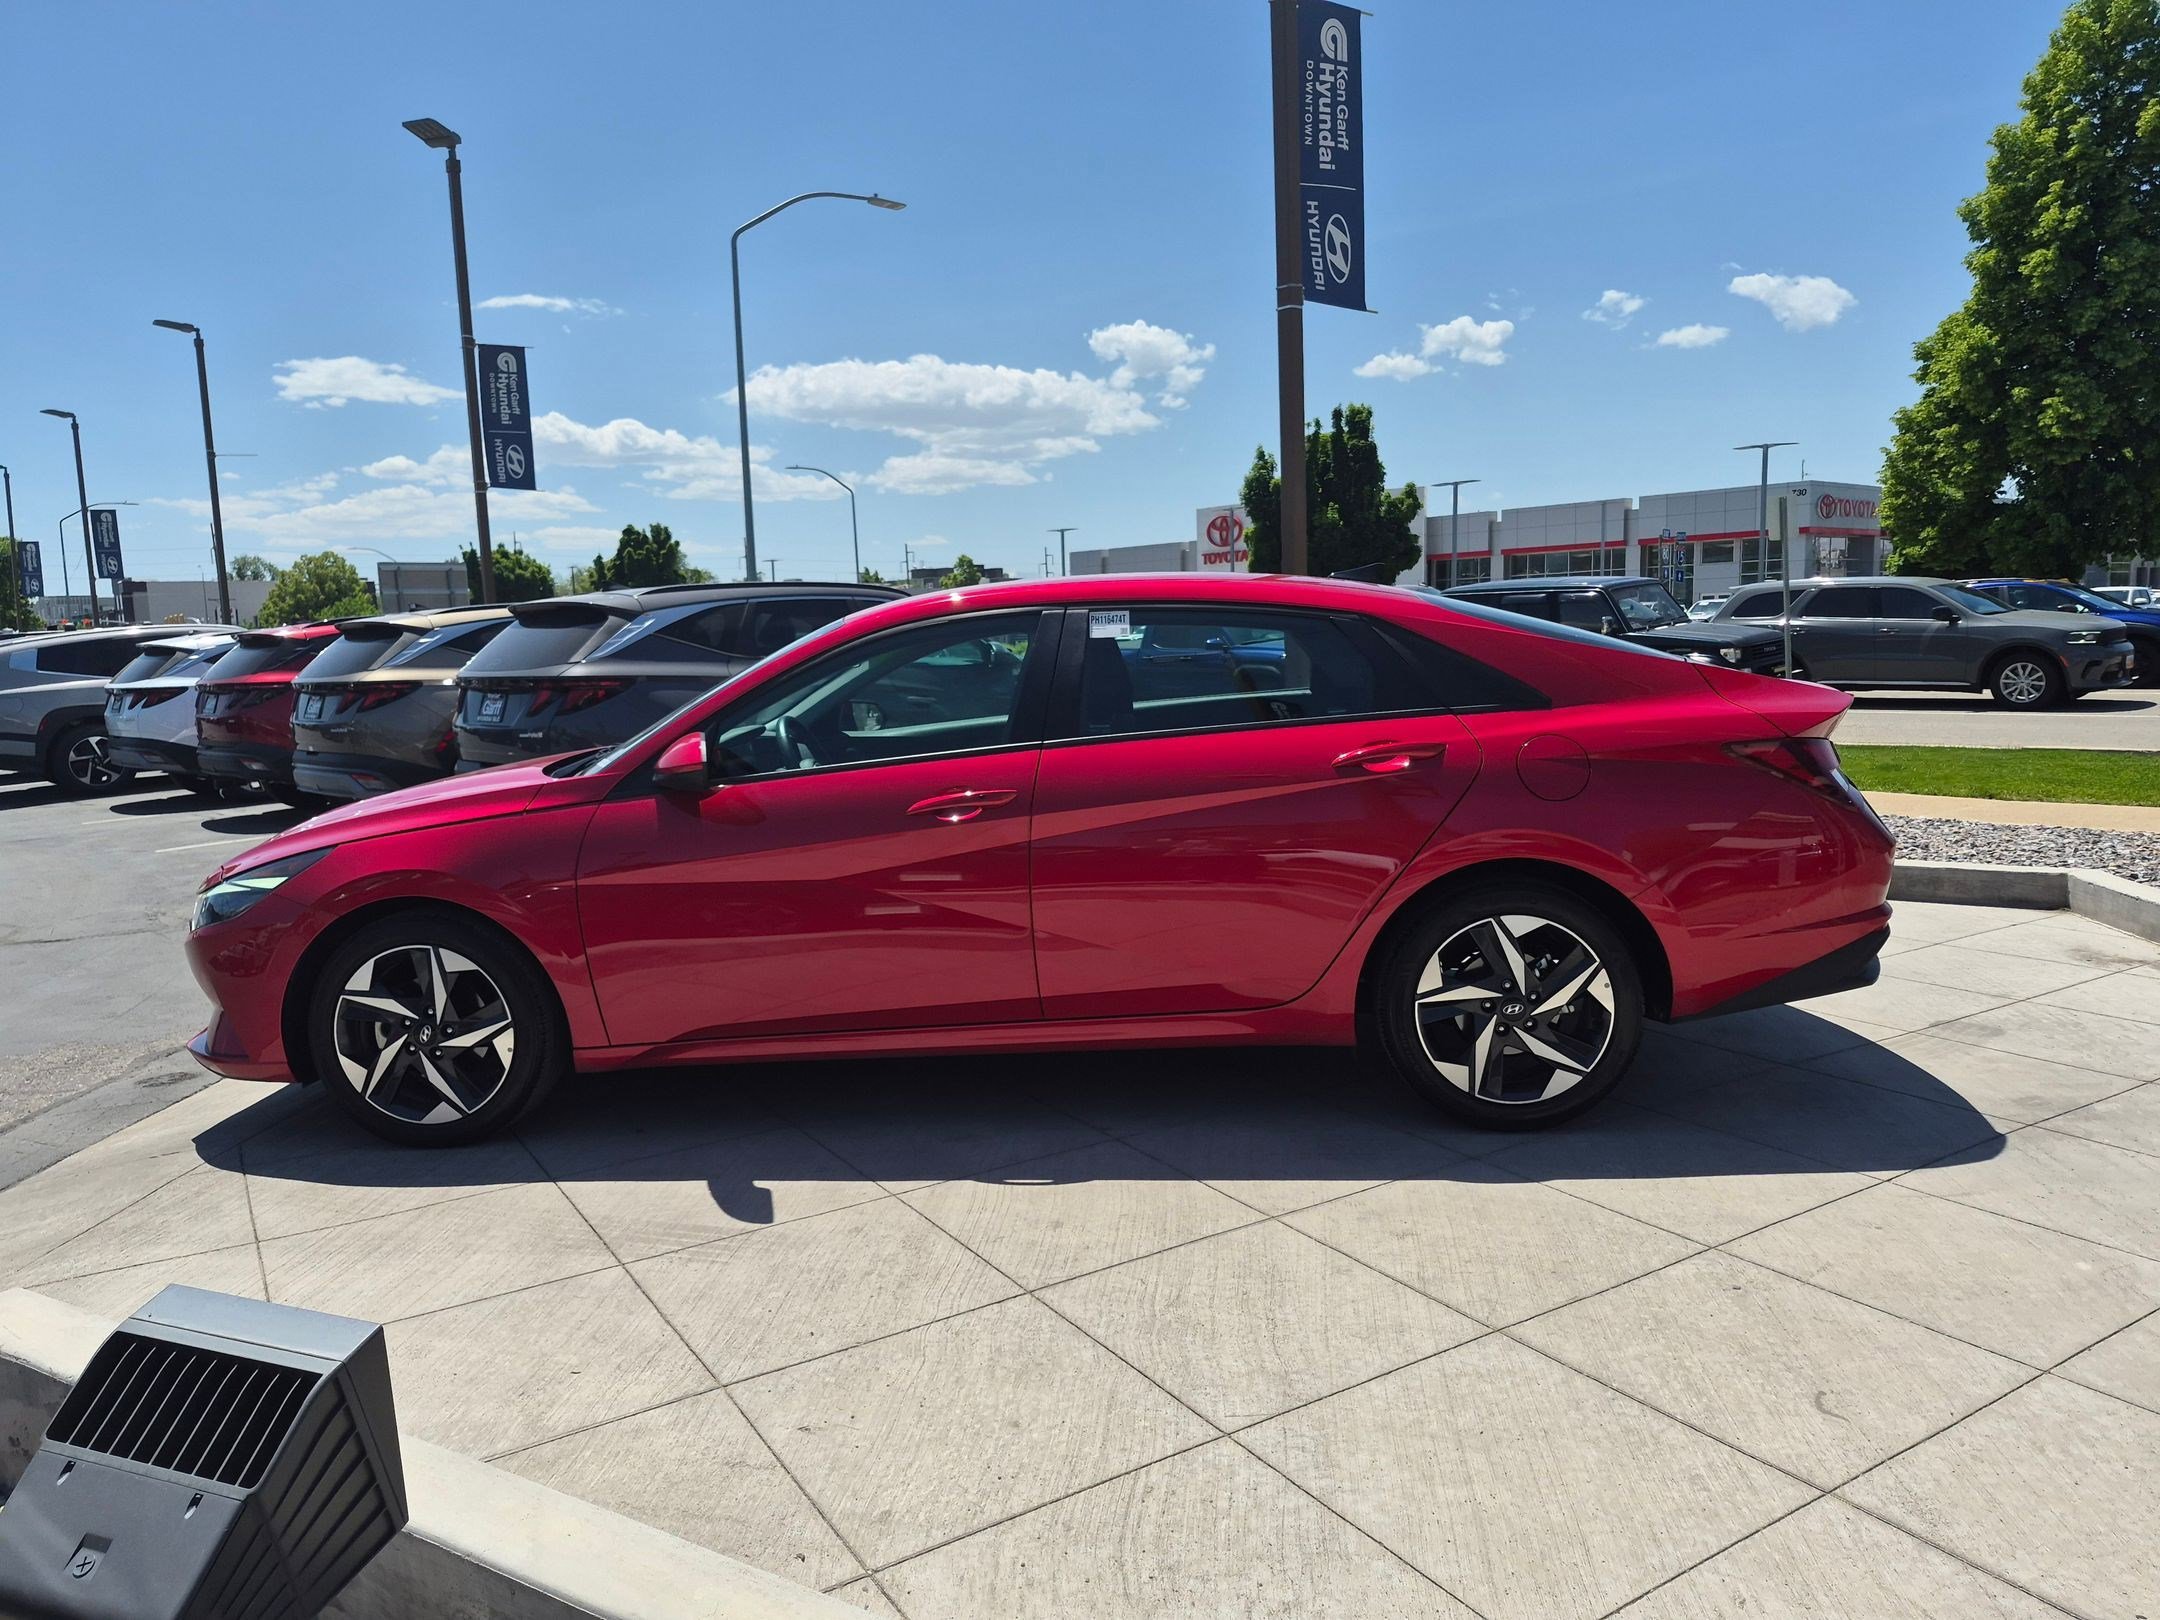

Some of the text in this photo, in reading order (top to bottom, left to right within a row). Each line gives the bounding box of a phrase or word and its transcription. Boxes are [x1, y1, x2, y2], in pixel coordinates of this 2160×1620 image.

[1304, 60, 1314, 146] DOWNTOWN
[1316, 62, 1336, 170] Hyundai
[1336, 65, 1349, 151] Ken Garff
[1306, 200, 1326, 291] HYUNDAI
[496, 373, 512, 425] Hyundai
[510, 374, 518, 391] Ken
[494, 439, 506, 483] HYUNDAI
[1835, 498, 1877, 518] TOYOTA
[1201, 549, 1248, 565] TOYOTA
